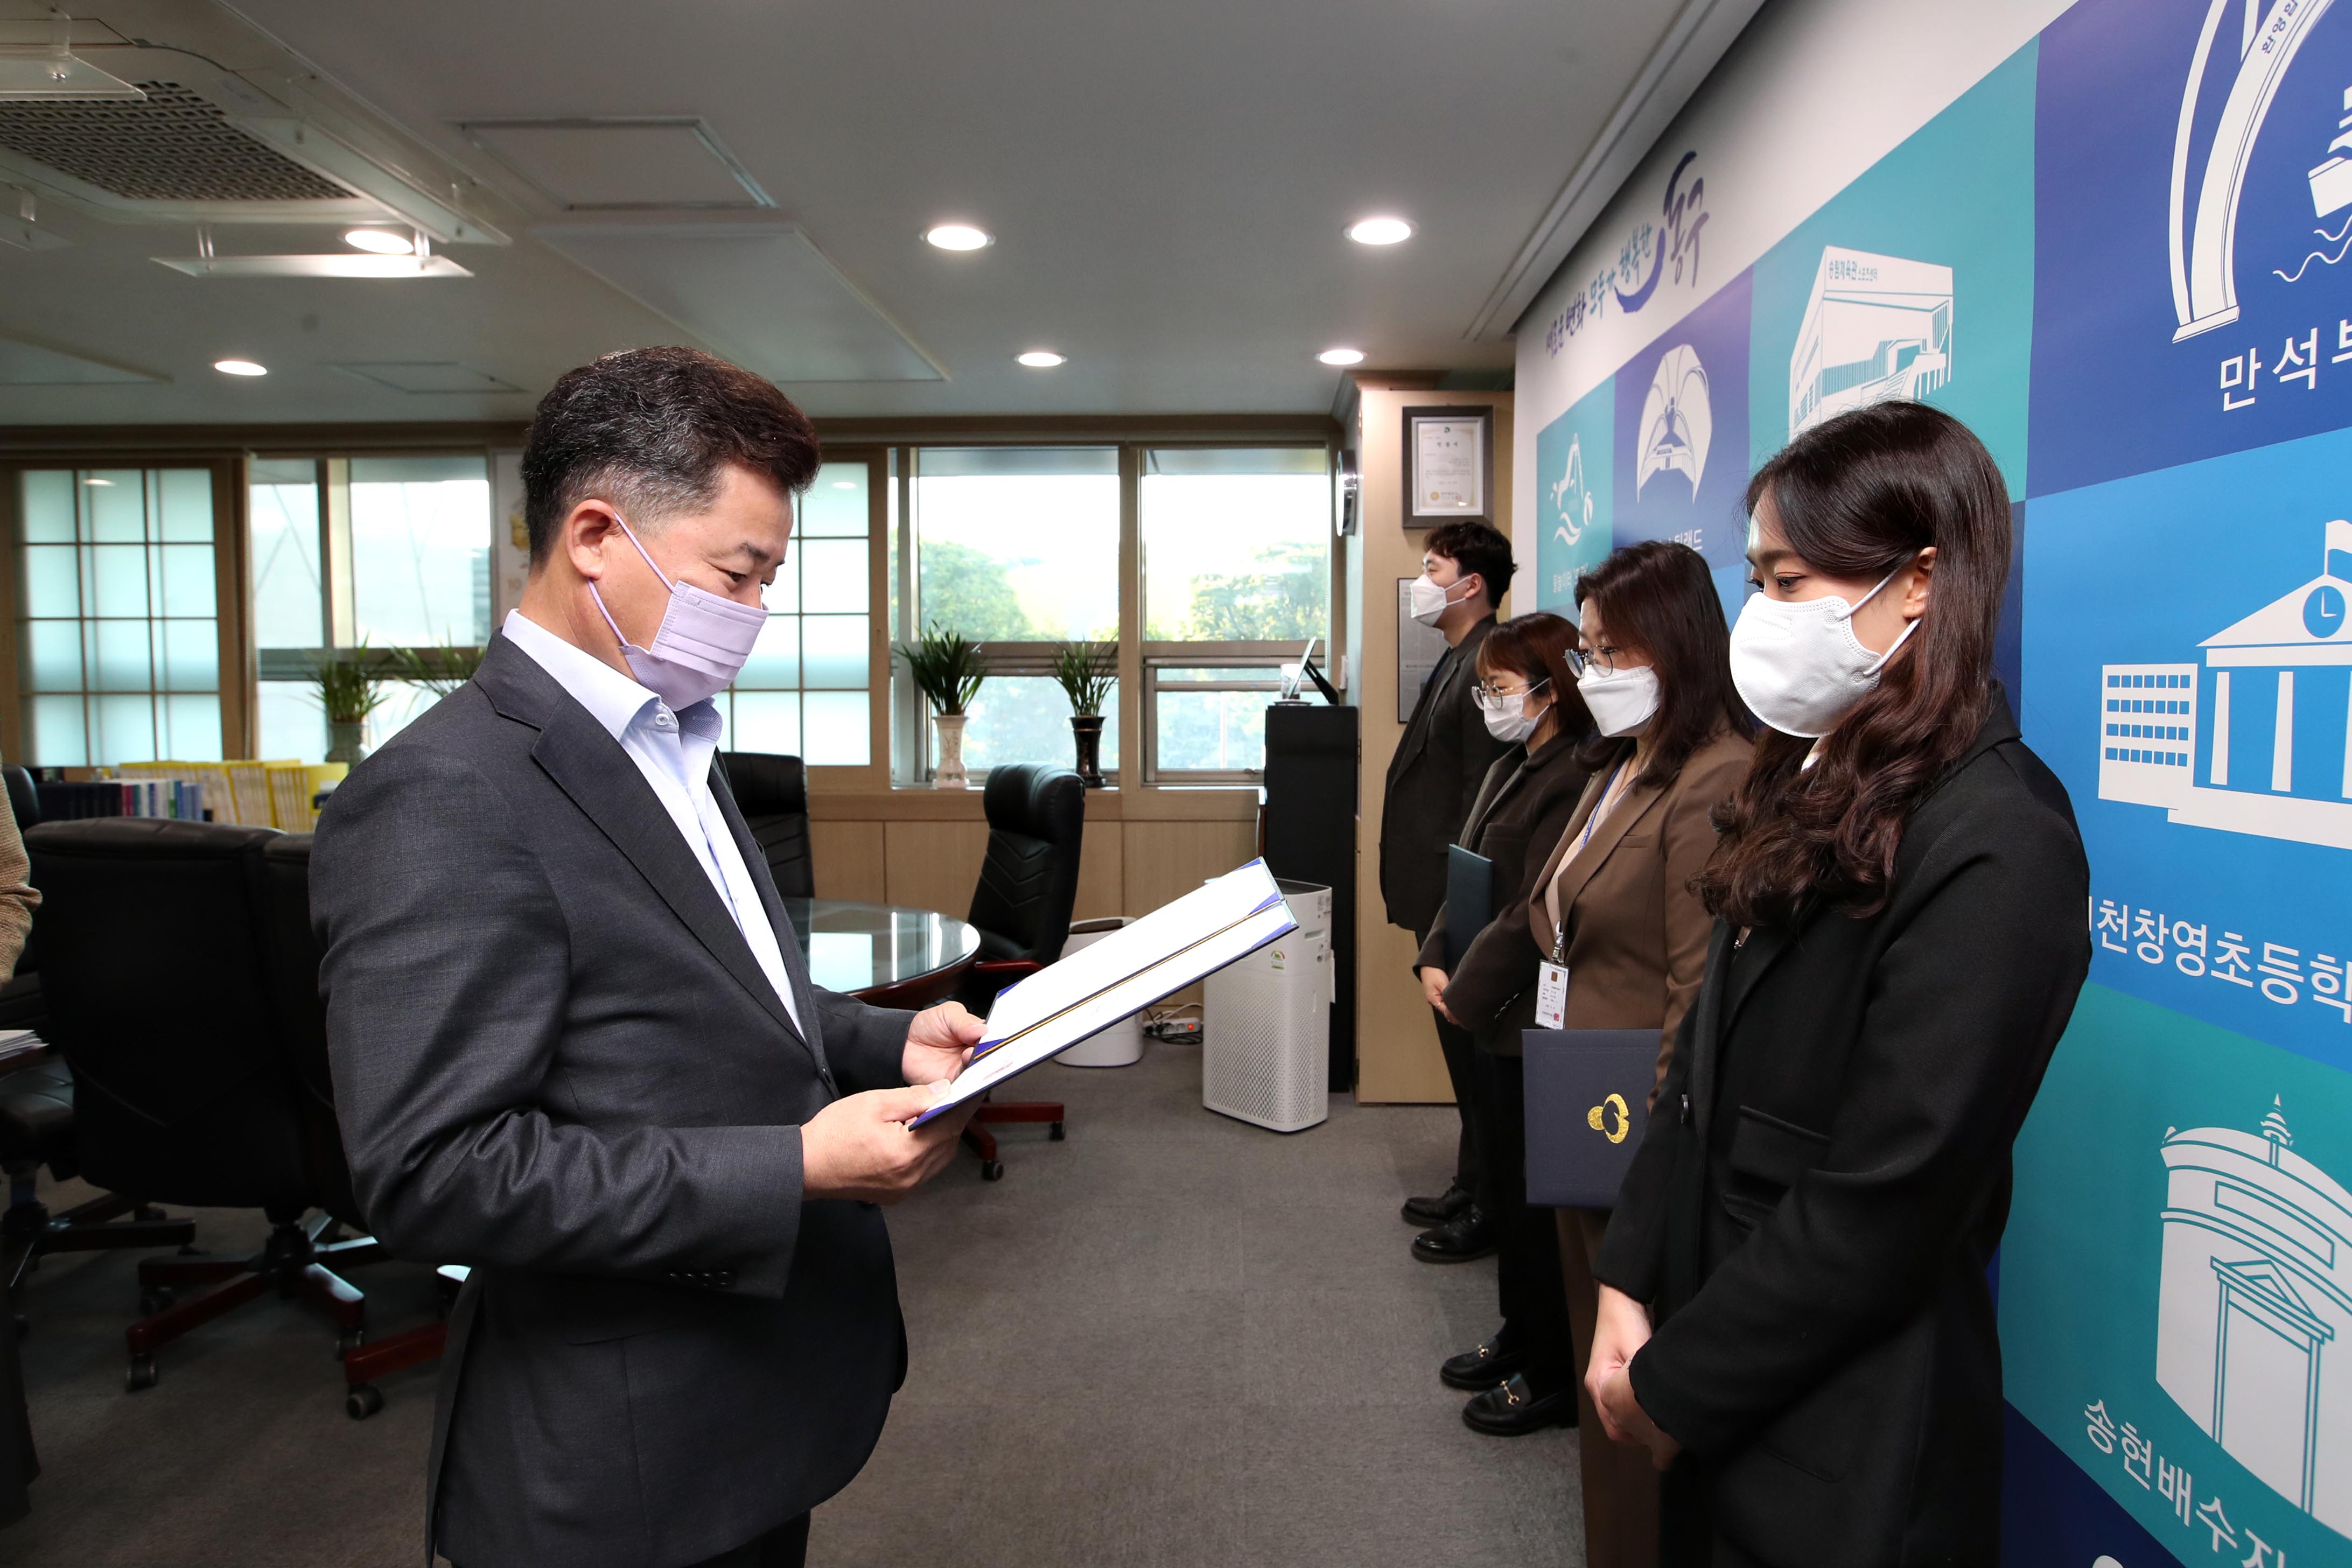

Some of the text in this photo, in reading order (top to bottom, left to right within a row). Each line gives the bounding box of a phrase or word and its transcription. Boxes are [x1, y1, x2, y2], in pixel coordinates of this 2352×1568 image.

[1565, 291, 1587, 337] 변화
[1619, 223, 1652, 285] 행복한
[2088, 895, 2352, 1023] 천창영초등학
